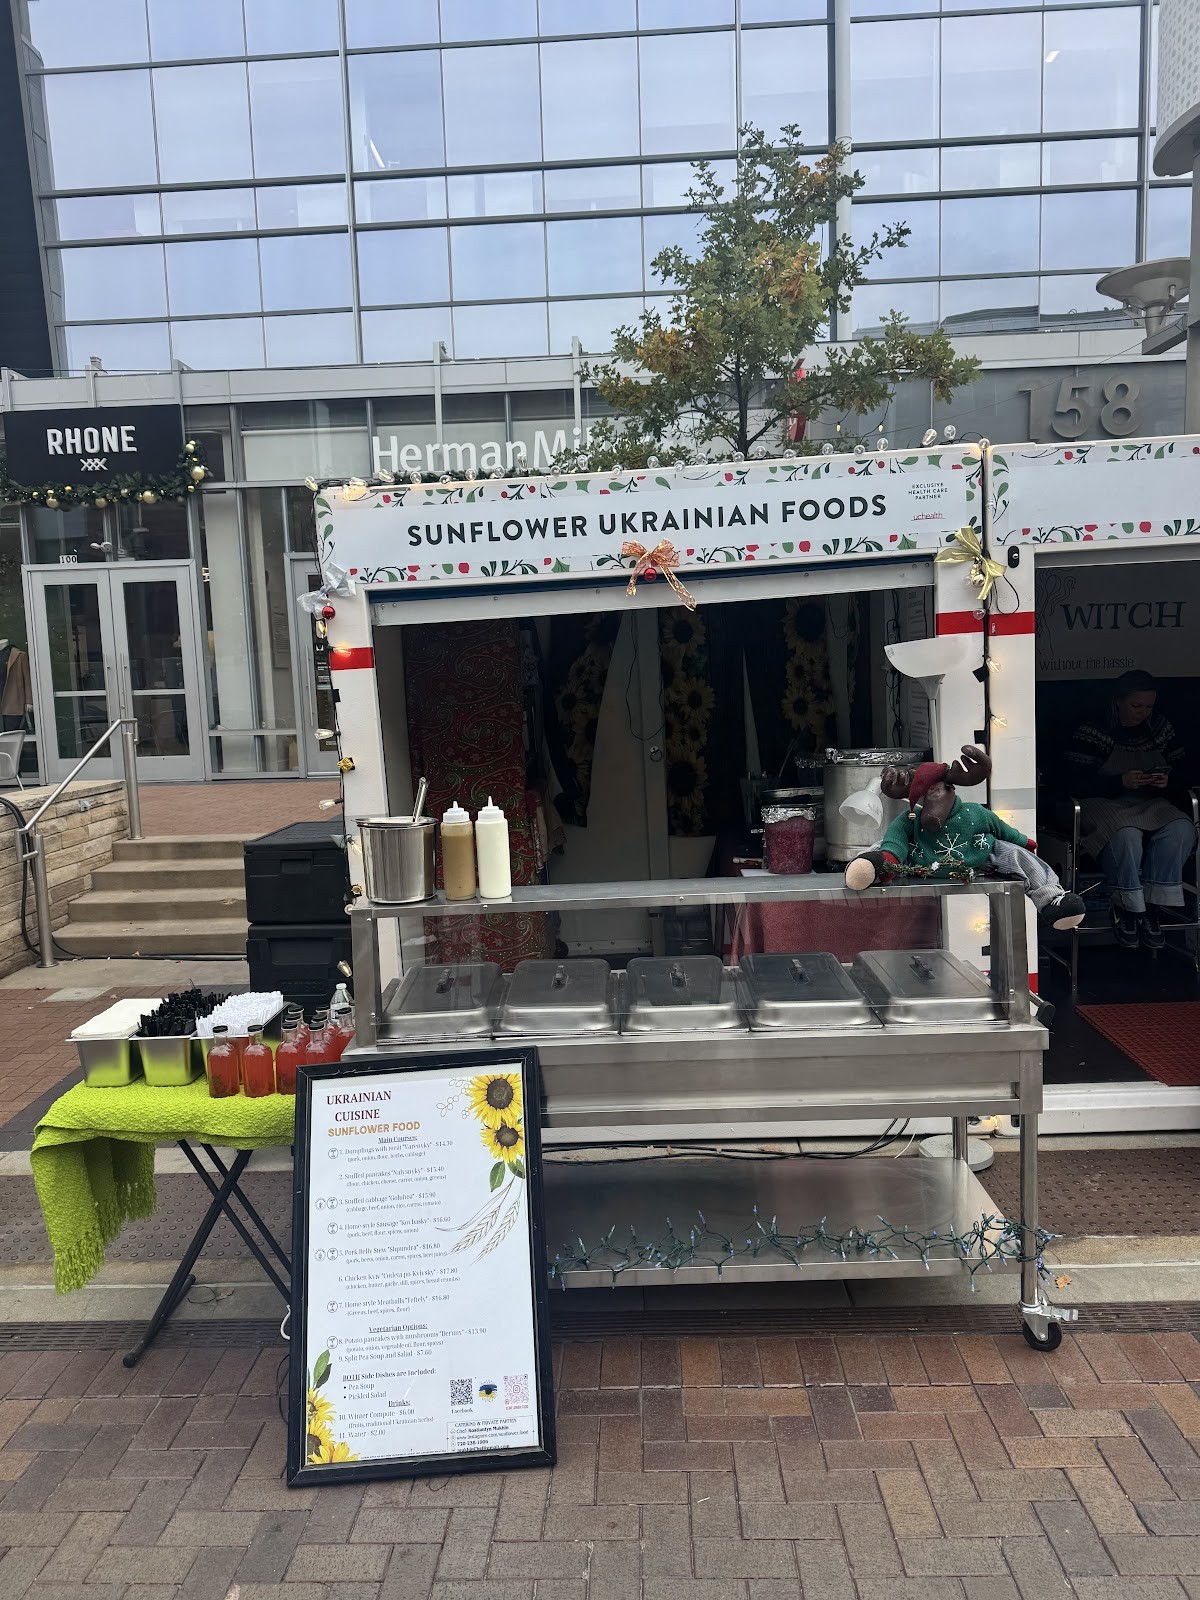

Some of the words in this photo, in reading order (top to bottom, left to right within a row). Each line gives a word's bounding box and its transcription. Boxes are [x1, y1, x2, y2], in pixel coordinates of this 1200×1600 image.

[1018, 375, 1140, 440] 158
[46, 425, 137, 455] RHONE
[407, 515, 588, 547] SUNFLOWER
[598, 502, 769, 535] UKRAINIAN
[781, 494, 886, 523] FOODS
[913, 511, 943, 521] uchealth
[60, 555, 77, 563] 100
[1060, 601, 1187, 631] WITCH
[1039, 658, 1083, 671] without
[1086, 658, 1100, 670] the
[1103, 656, 1135, 669] hassle
[327, 1090, 392, 1105] UKRAINIAN
[335, 1109, 380, 1122] CUISINE
[328, 1123, 390, 1137] SUNFLOWER
[393, 1121, 421, 1132] FOOD
[378, 1136, 393, 1144] Main
[345, 1147, 374, 1156] Dumplings
[345, 1172, 365, 1180] Stuffed
[365, 1171, 390, 1179] pancakes
[345, 1197, 365, 1205] Stuffed
[362, 1222, 376, 1230] style
[344, 1274, 367, 1282] Chicken
[439, 1267, 458, 1275] $17.80
[362, 1300, 376, 1308] style
[377, 1297, 405, 1306] Meatballs
[369, 1325, 402, 1334] Vegetarian
[402, 1323, 428, 1332] Options:
[344, 1337, 363, 1345] Potato
[363, 1336, 391, 1344] pancakes
[390, 1333, 405, 1341] with
[405, 1331, 439, 1340] mushrooms
[381, 1342, 404, 1350] vegetable
[344, 1355, 358, 1363] Split
[369, 1353, 385, 1361] Soup
[385, 1351, 397, 1359] and
[342, 1374, 361, 1382] BOTH
[361, 1372, 375, 1380] Side
[375, 1371, 396, 1379] Dishes
[407, 1368, 437, 1376] Included:
[360, 1383, 375, 1391] Soup
[348, 1392, 370, 1400] Pickled
[370, 1391, 387, 1399] Salad
[388, 1399, 411, 1408] Drinks:
[369, 1410, 395, 1419] Compote
